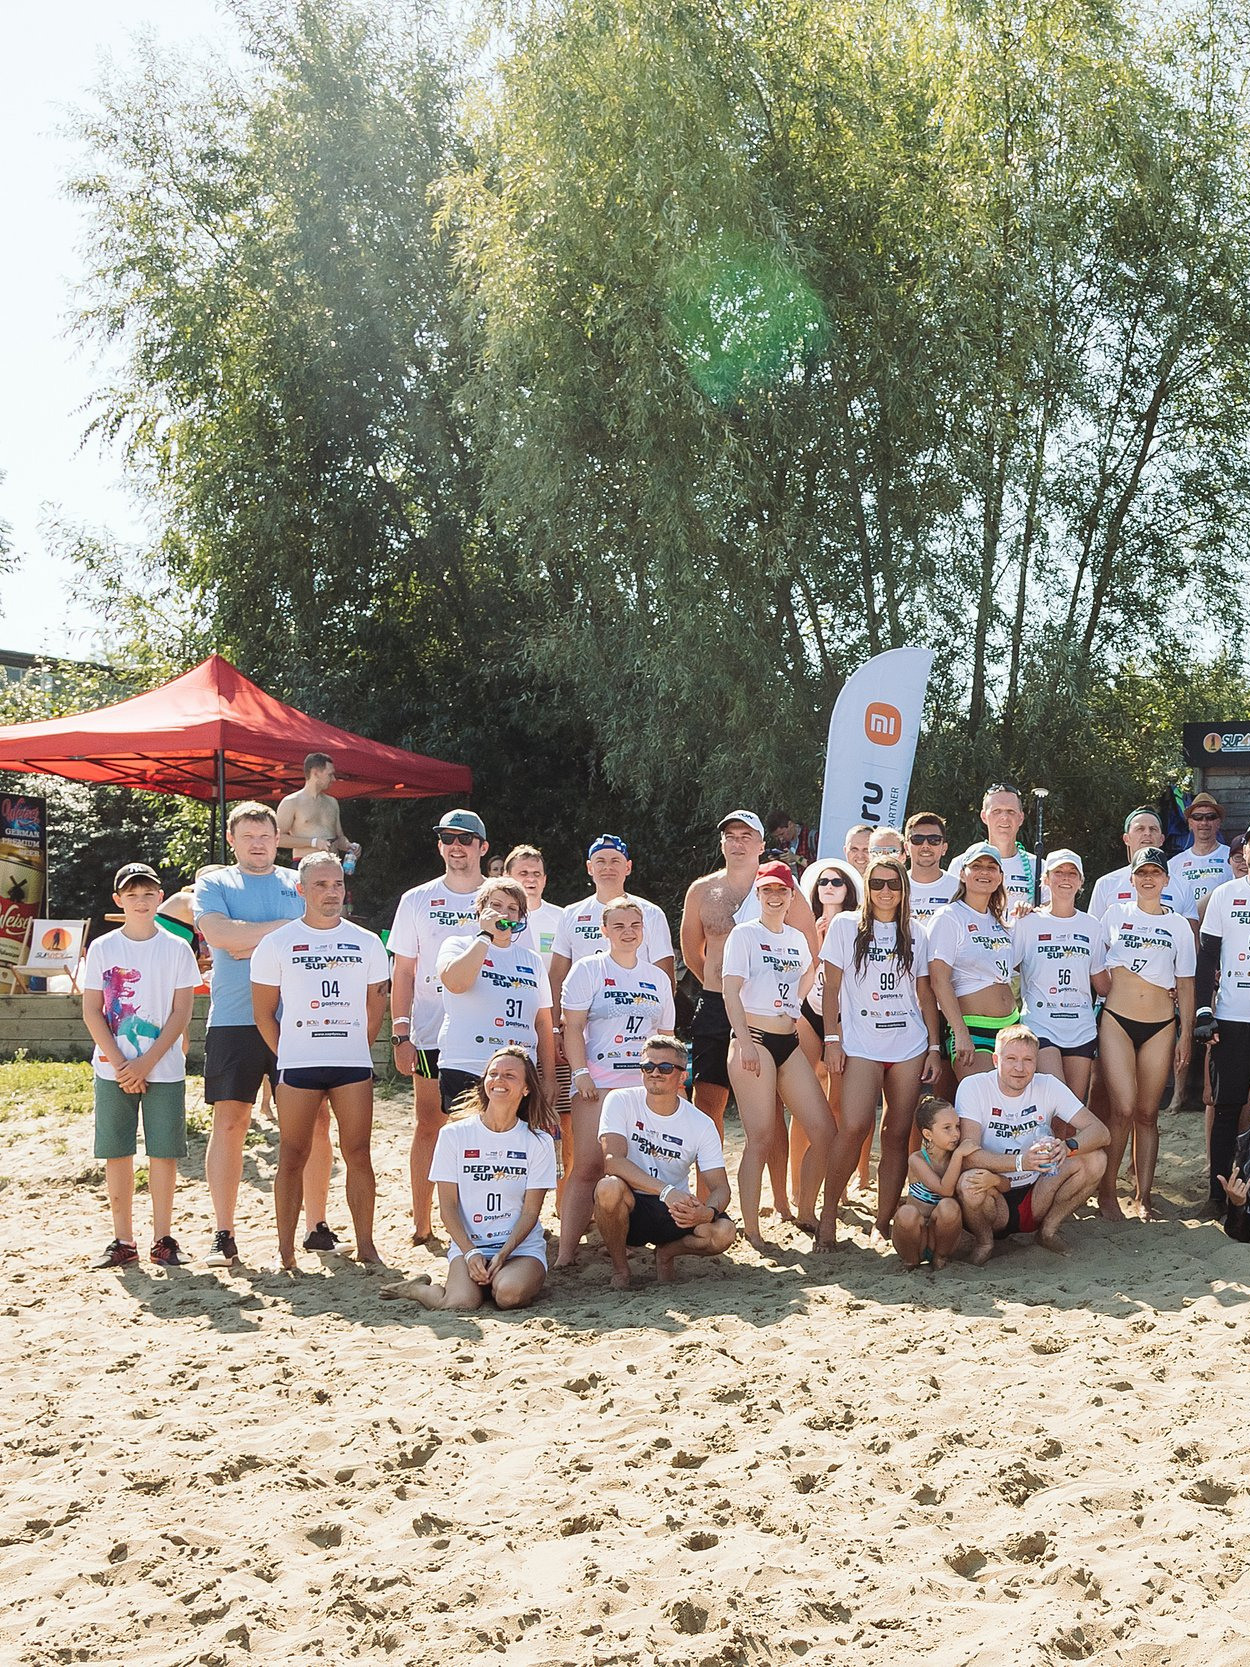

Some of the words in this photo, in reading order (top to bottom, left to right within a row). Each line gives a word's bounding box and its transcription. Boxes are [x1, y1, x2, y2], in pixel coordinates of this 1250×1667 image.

[5, 828, 40, 838] GERMAN
[2, 837, 40, 848] PREMIUM
[1199, 867, 1224, 875] WATER
[430, 911, 455, 919] DEEP
[439, 918, 459, 926] SUP
[575, 926, 600, 934] DEEP
[584, 932, 603, 940] SUP
[1124, 940, 1141, 948] SUP
[1141, 936, 1172, 948] WATER
[1062, 946, 1090, 956] WATER
[292, 955, 321, 964] DEEP
[323, 956, 363, 964] WATER
[869, 954, 887, 962] SUP
[1130, 959, 1147, 973] 57
[481, 970, 506, 980] DEEP
[1058, 969, 1071, 985] 56
[493, 979, 512, 988] SUP
[880, 972, 895, 990] 99
[322, 980, 341, 998] 04
[604, 991, 628, 999] DEEP
[615, 997, 635, 1005] SUP
[506, 998, 523, 1019] 31
[626, 1016, 644, 1033] 47
[988, 1121, 1009, 1130] DEEP
[995, 1130, 1013, 1138] SUP
[649, 1141, 681, 1159] WATER
[463, 1165, 490, 1173] DEEP
[492, 1165, 527, 1175] WATER
[473, 1173, 494, 1181] SUP
[487, 1193, 501, 1211] 01
